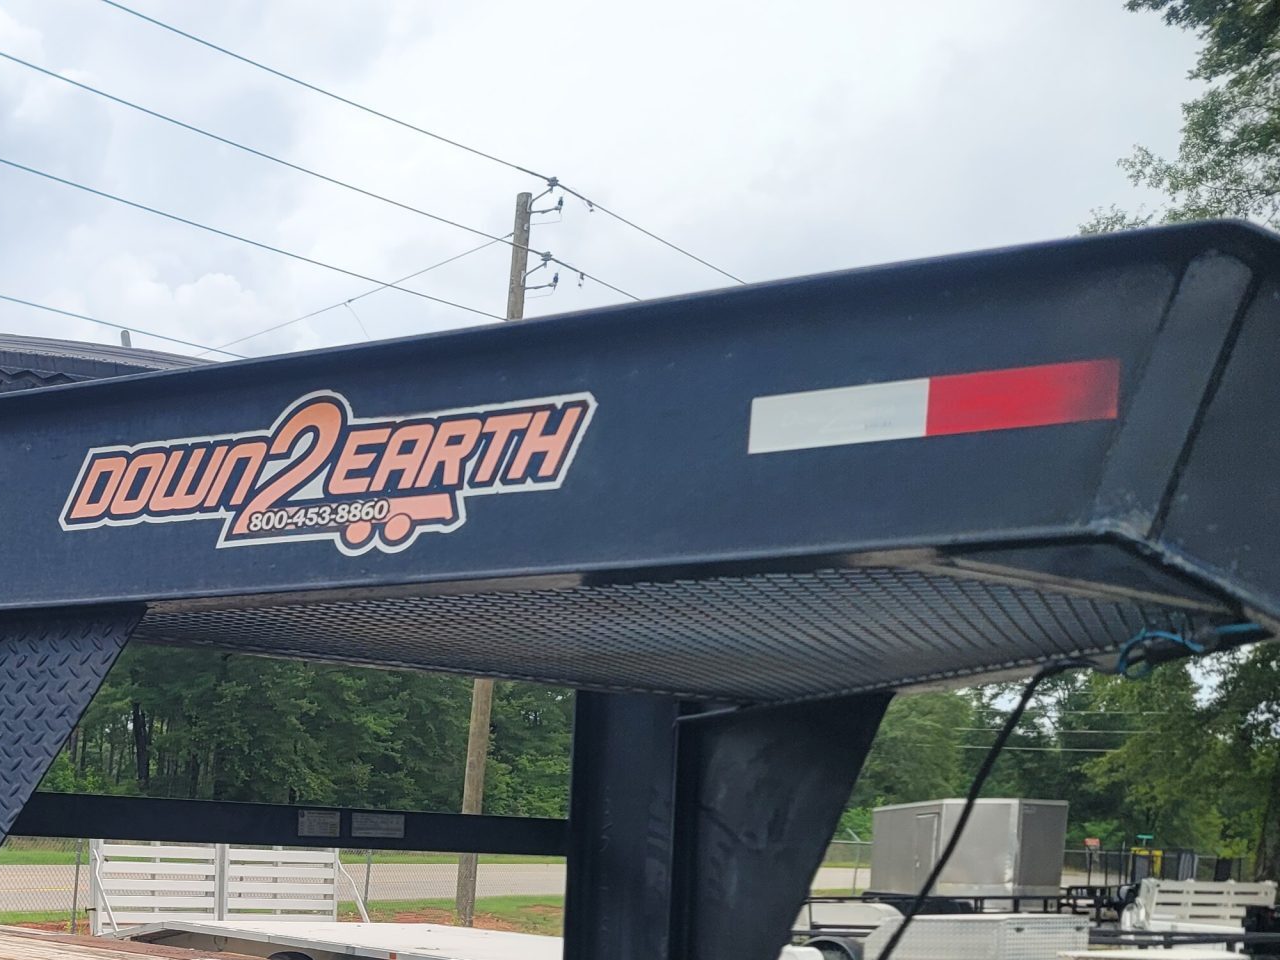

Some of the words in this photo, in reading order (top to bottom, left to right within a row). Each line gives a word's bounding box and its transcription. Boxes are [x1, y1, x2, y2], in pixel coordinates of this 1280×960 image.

[69, 439, 270, 521] DOWN
[232, 400, 344, 535] 2
[326, 404, 585, 497] EARTH
[248, 497, 390, 533] 800-453-8860
